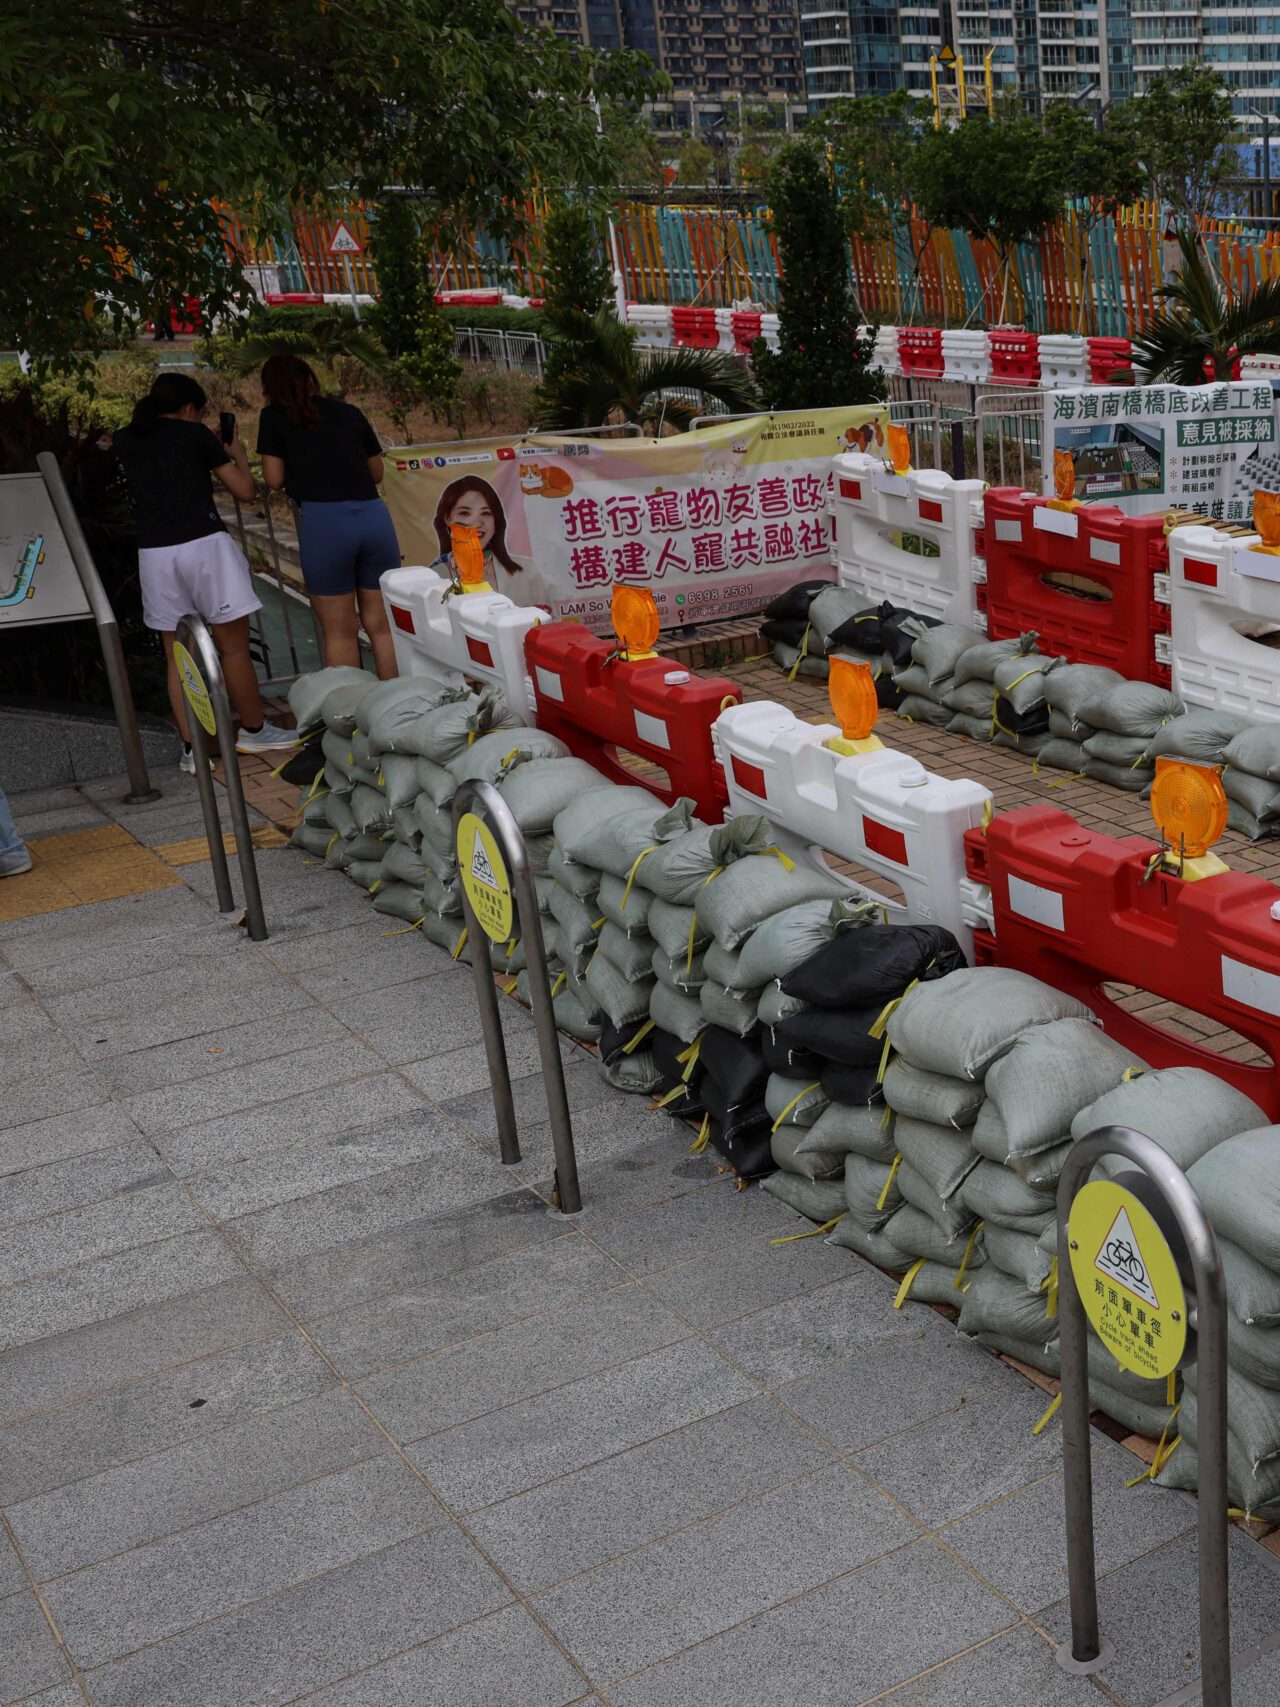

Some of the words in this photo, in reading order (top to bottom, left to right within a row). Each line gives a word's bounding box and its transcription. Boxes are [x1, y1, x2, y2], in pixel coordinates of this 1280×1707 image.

[1053, 387, 1271, 421] 海濱南橋橋底改善工程
[768, 421, 815, 432] SK1002/2022
[1182, 419, 1271, 445] 意見被採納
[1182, 452, 1237, 467] 計劃移除石屎磚
[562, 470, 833, 539] 推行寵物友善政
[1182, 481, 1215, 494] 兩組座椅
[571, 517, 837, 584] 構建人寵共融社
[560, 602, 588, 616] LAM
[589, 601, 604, 612] So
[688, 590, 719, 604] 6398
[724, 584, 753, 599] 2561
[1094, 1277, 1162, 1338] 前面單車徑
[1100, 1315, 1118, 1335] Cycle
[1119, 1330, 1136, 1347] track
[1137, 1344, 1158, 1364] ahead
[1102, 1302, 1155, 1349] 小心單車
[1099, 1324, 1123, 1348] Beware
[1133, 1349, 1160, 1375] bicycles
